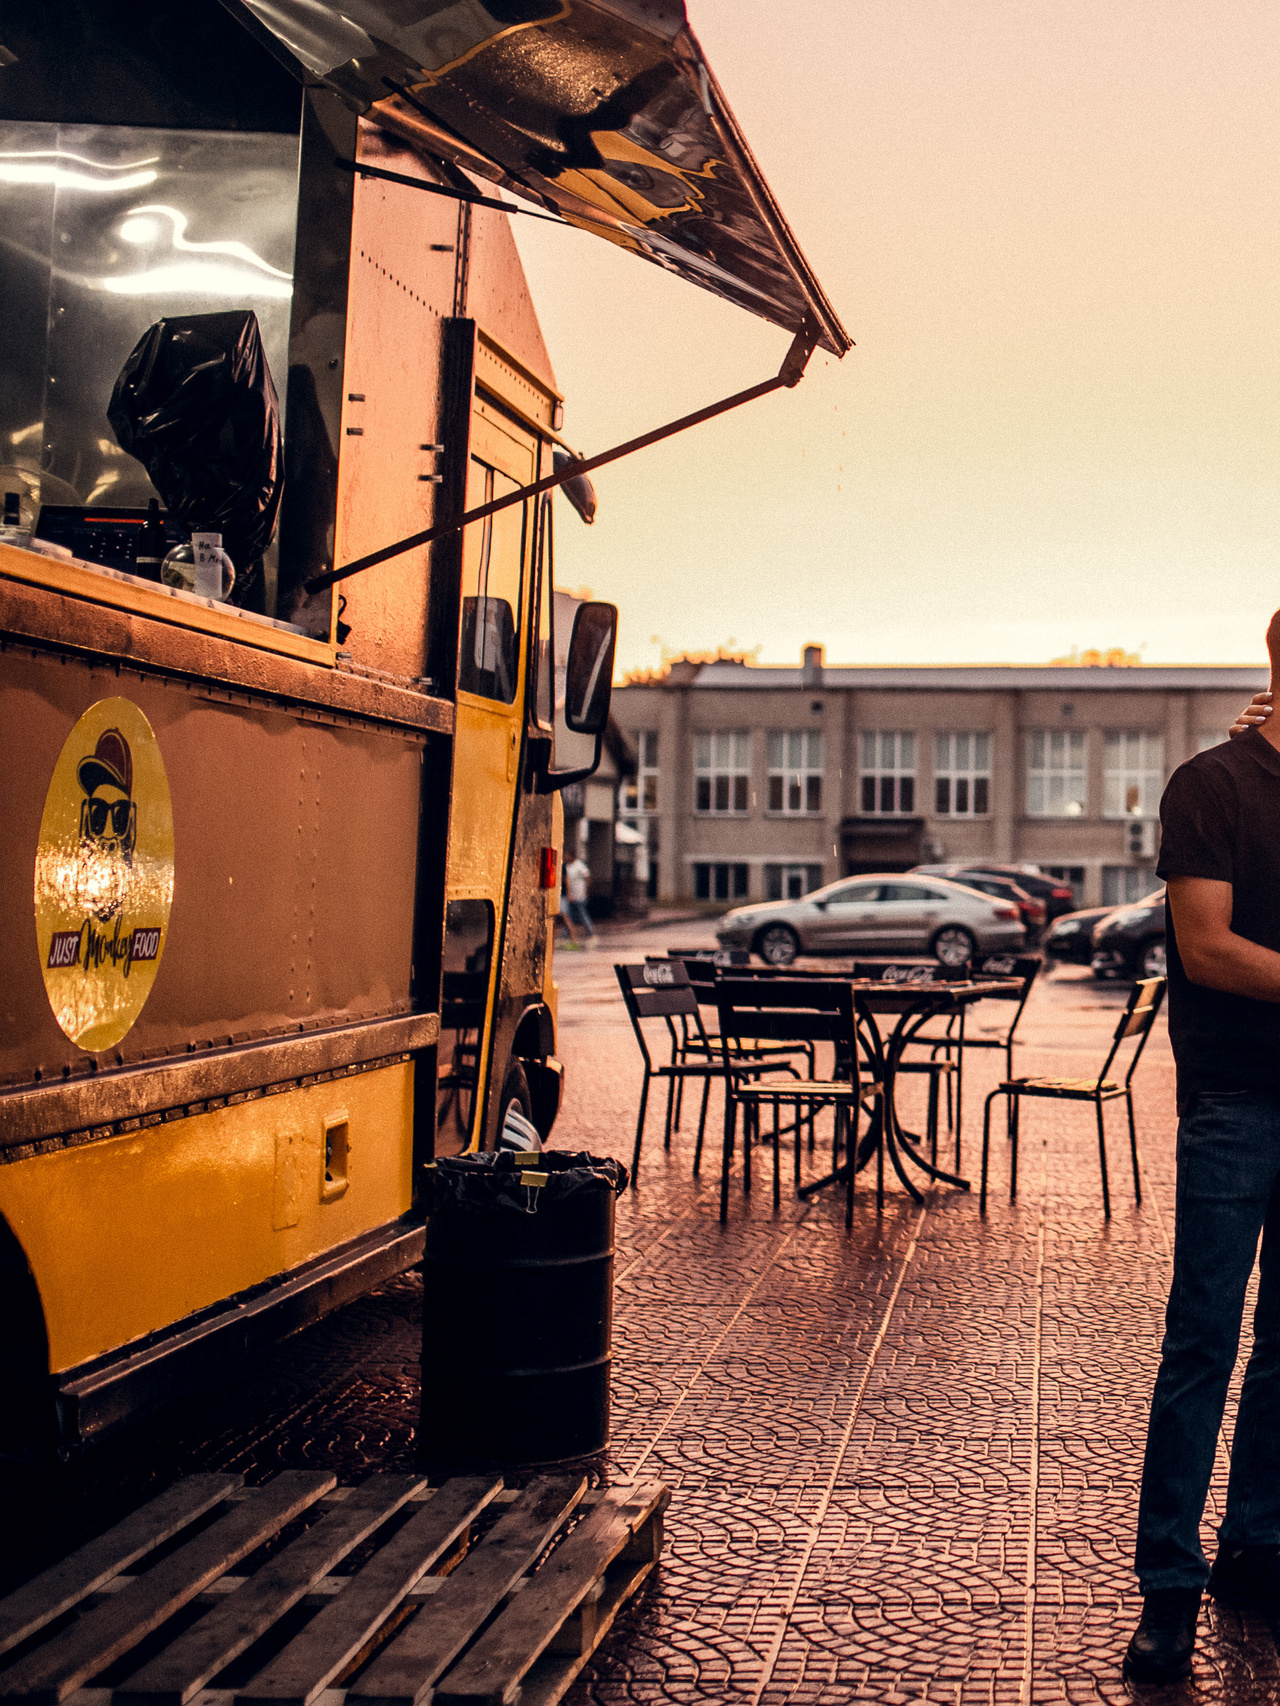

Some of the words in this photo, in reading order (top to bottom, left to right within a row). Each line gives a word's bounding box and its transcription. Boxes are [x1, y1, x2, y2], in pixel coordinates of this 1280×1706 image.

[50, 936, 79, 965] JUST
[78, 914, 131, 979] Monkey
[132, 932, 159, 957] FOOD
